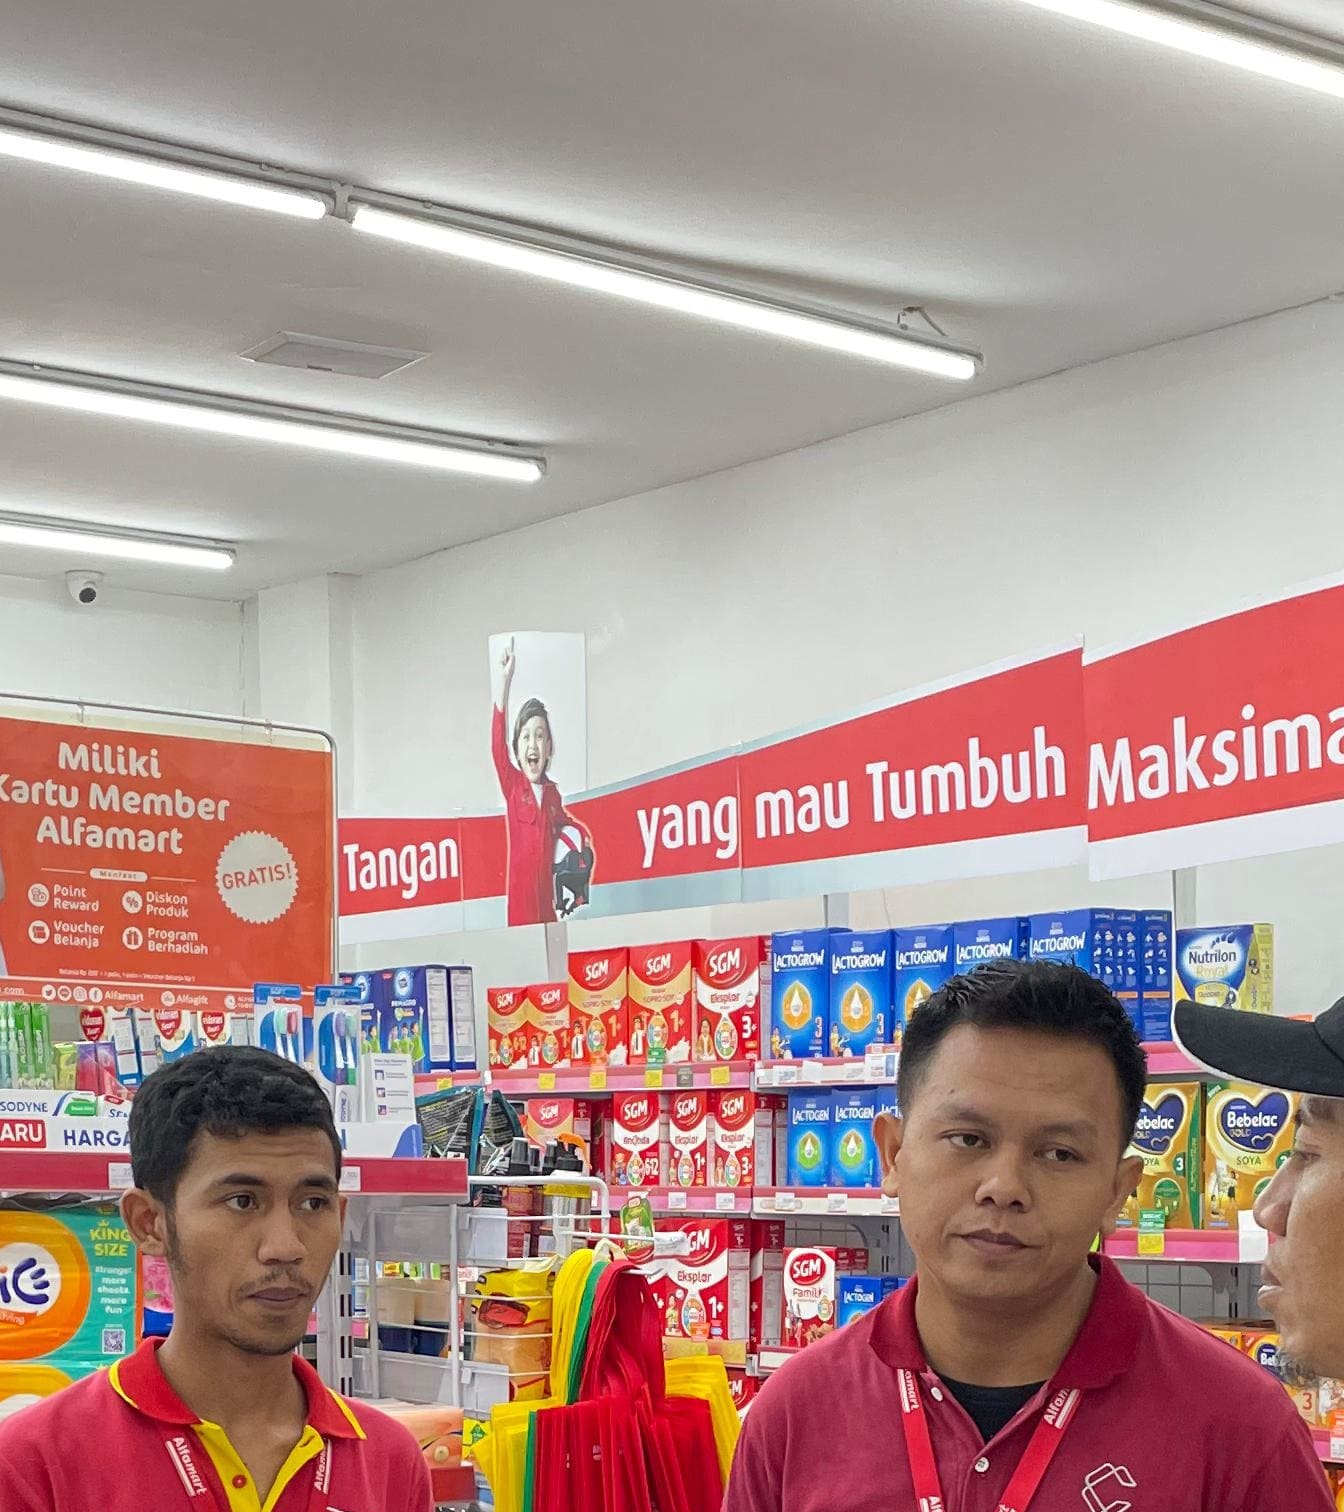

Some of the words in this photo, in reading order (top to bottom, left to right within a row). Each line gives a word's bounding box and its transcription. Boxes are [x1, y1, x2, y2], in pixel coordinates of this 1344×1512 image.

[59, 741, 162, 780] Miliki
[88, 784, 230, 823] Member
[343, 838, 459, 900] Tangan
[638, 793, 738, 869] yang
[755, 778, 849, 842] mau
[867, 724, 1066, 823] Tumbuh
[37, 816, 183, 855] Alfamart
[221, 862, 293, 890] GRATIS!
[53, 884, 87, 898] Point
[146, 891, 188, 905] Diskon
[53, 898, 100, 912] Reward
[146, 904, 189, 918] Produk
[53, 920, 105, 935] Voucher
[147, 927, 198, 944] Program
[53, 934, 100, 950] Belanja
[147, 940, 209, 956] Berhadiah
[1029, 931, 1087, 958] LACTOGROW
[773, 949, 825, 973] LACTOGROW
[895, 945, 948, 971] LACTOGROW
[956, 938, 1013, 966] LACTOGROW
[1188, 950, 1237, 965] Nutrilon
[585, 959, 609, 982] SGM
[646, 953, 672, 976] SGM
[709, 947, 741, 978] SGM
[832, 949, 886, 976] LACTOGROW
[104, 989, 145, 1003] Alfamart
[623, 1099, 648, 1122] SGM
[675, 1098, 697, 1119] SGM
[720, 1097, 744, 1118] SGM
[792, 1107, 830, 1124] LACTOGEN
[835, 1103, 875, 1121] LACTOGEN
[1136, 1116, 1175, 1130] ebelac
[1226, 1111, 1279, 1129] Bebelac
[1176, 1157, 1185, 1172] 3
[1236, 1155, 1262, 1166] SOYA
[93, 1242, 129, 1257] SIZE
[677, 1269, 713, 1284] Eksplor
[791, 1258, 822, 1279] SGM
[843, 1291, 875, 1303] LACTOGEN
[105, 1305, 122, 1316] fun
[173, 1436, 208, 1496] Alfamart
